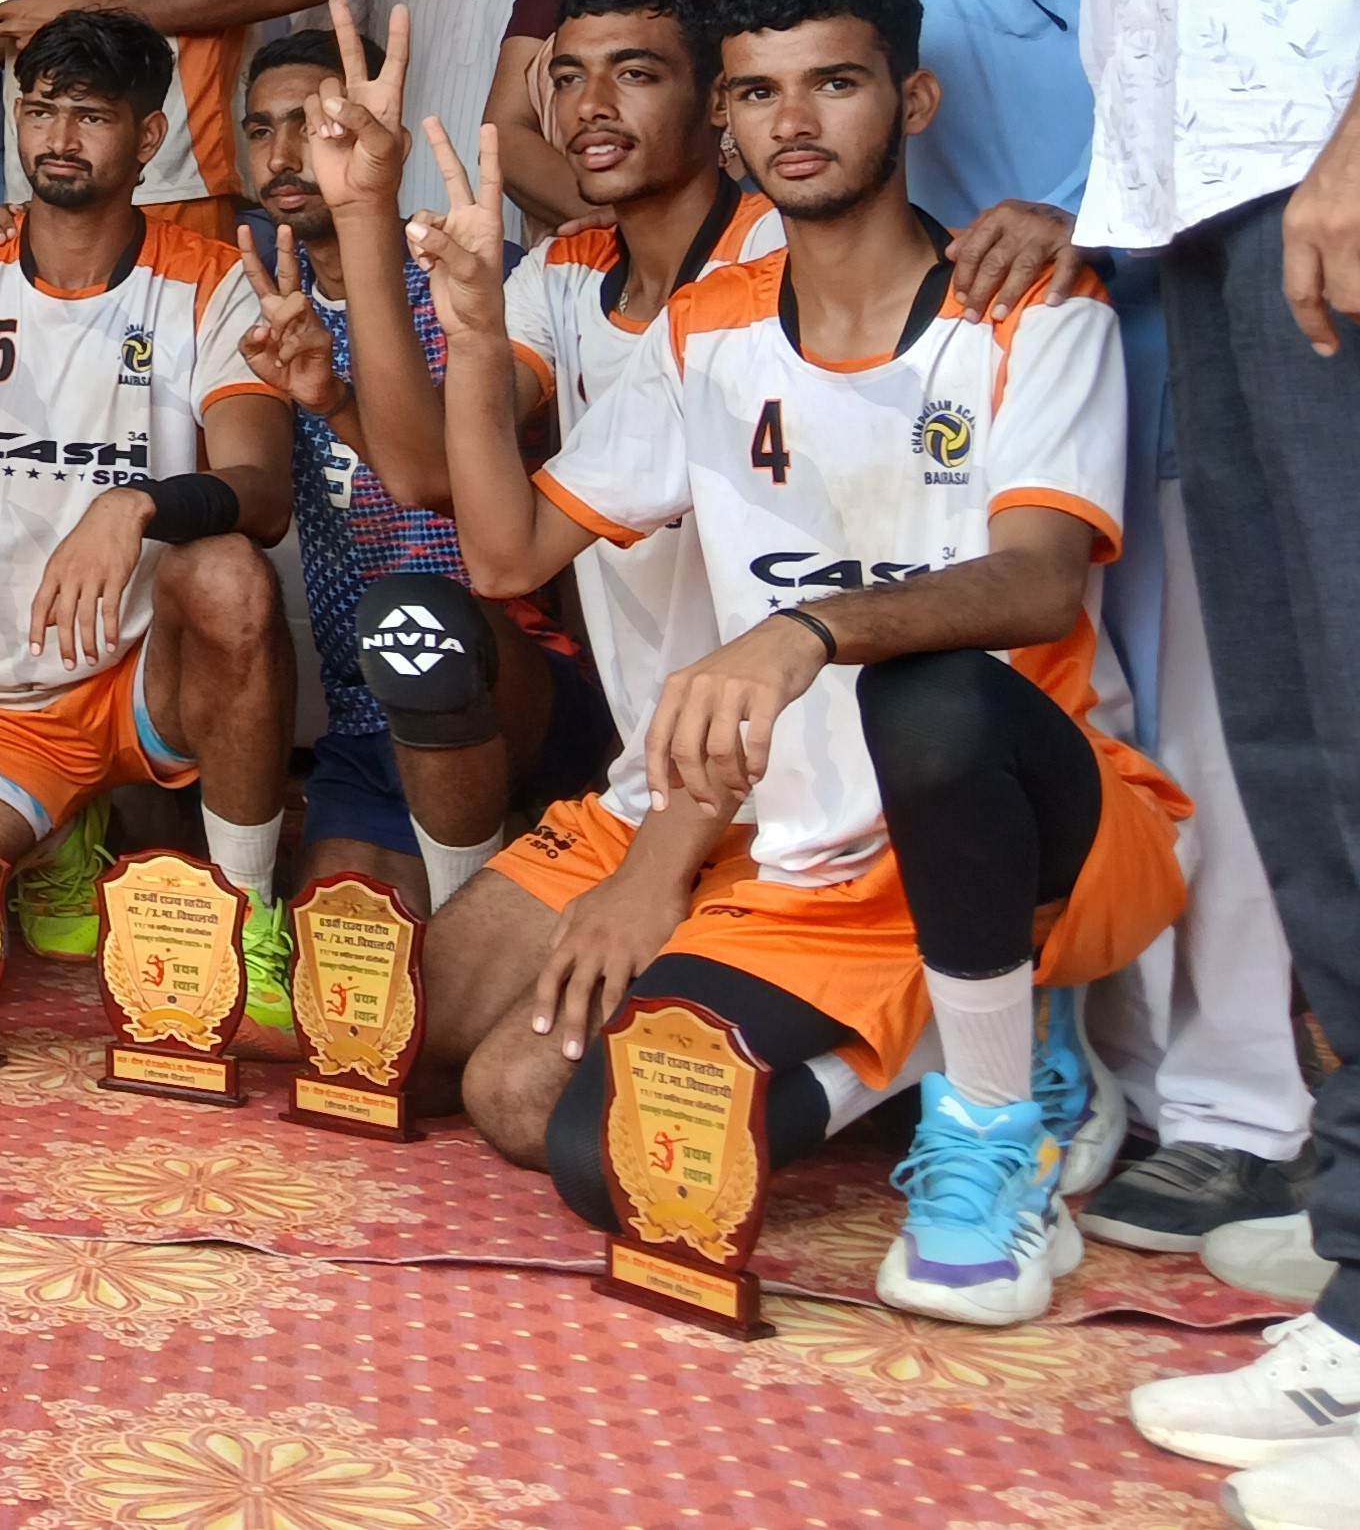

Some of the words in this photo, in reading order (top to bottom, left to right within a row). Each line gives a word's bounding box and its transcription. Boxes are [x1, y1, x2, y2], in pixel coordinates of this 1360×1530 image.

[127, 432, 148, 442] 34
[751, 398, 792, 485] 4
[750, 552, 930, 589] CAS
[362, 632, 465, 654] NIVIA
